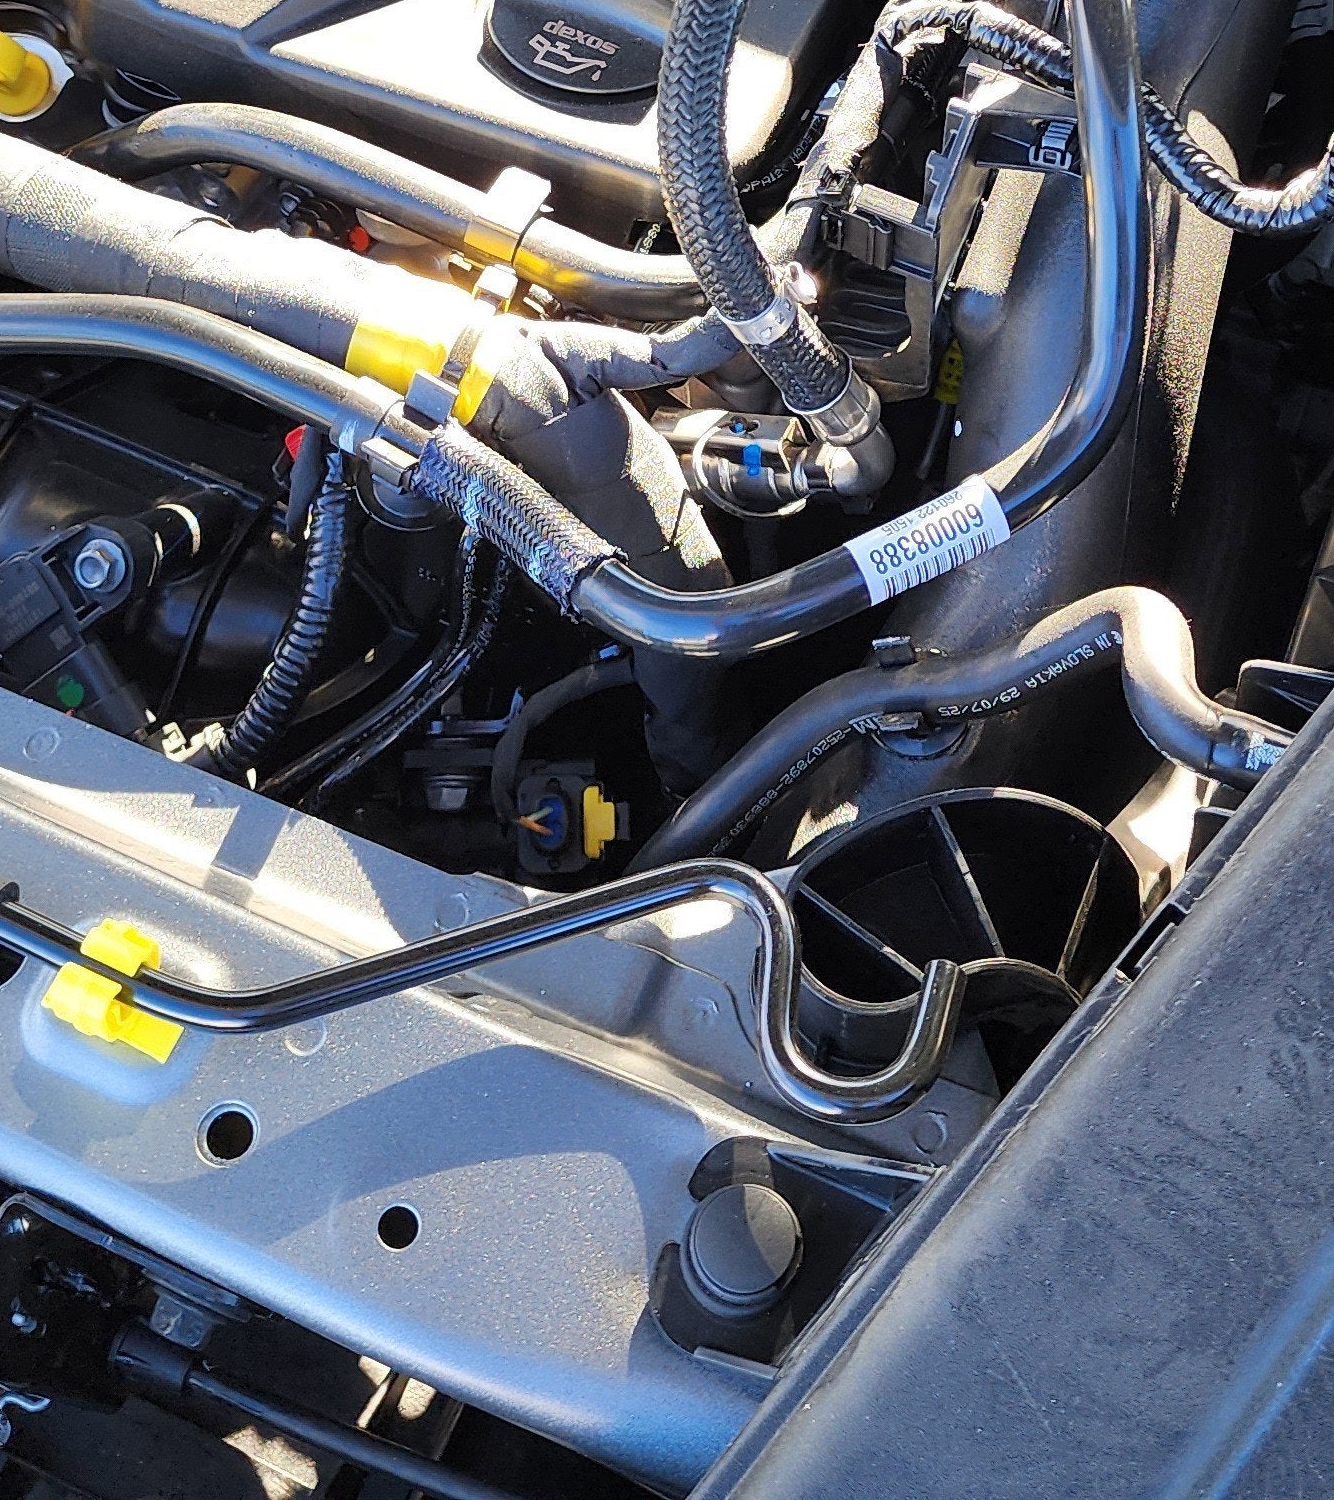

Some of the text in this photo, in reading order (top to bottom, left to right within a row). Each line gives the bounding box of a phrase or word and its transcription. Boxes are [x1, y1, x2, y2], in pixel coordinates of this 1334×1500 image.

[543, 19, 620, 55] dexos
[869, 504, 984, 574] 60008388
[881, 514, 913, 536] 1505
[1093, 631, 1113, 652] IN
[1024, 642, 1095, 690] SLOVAKIA
